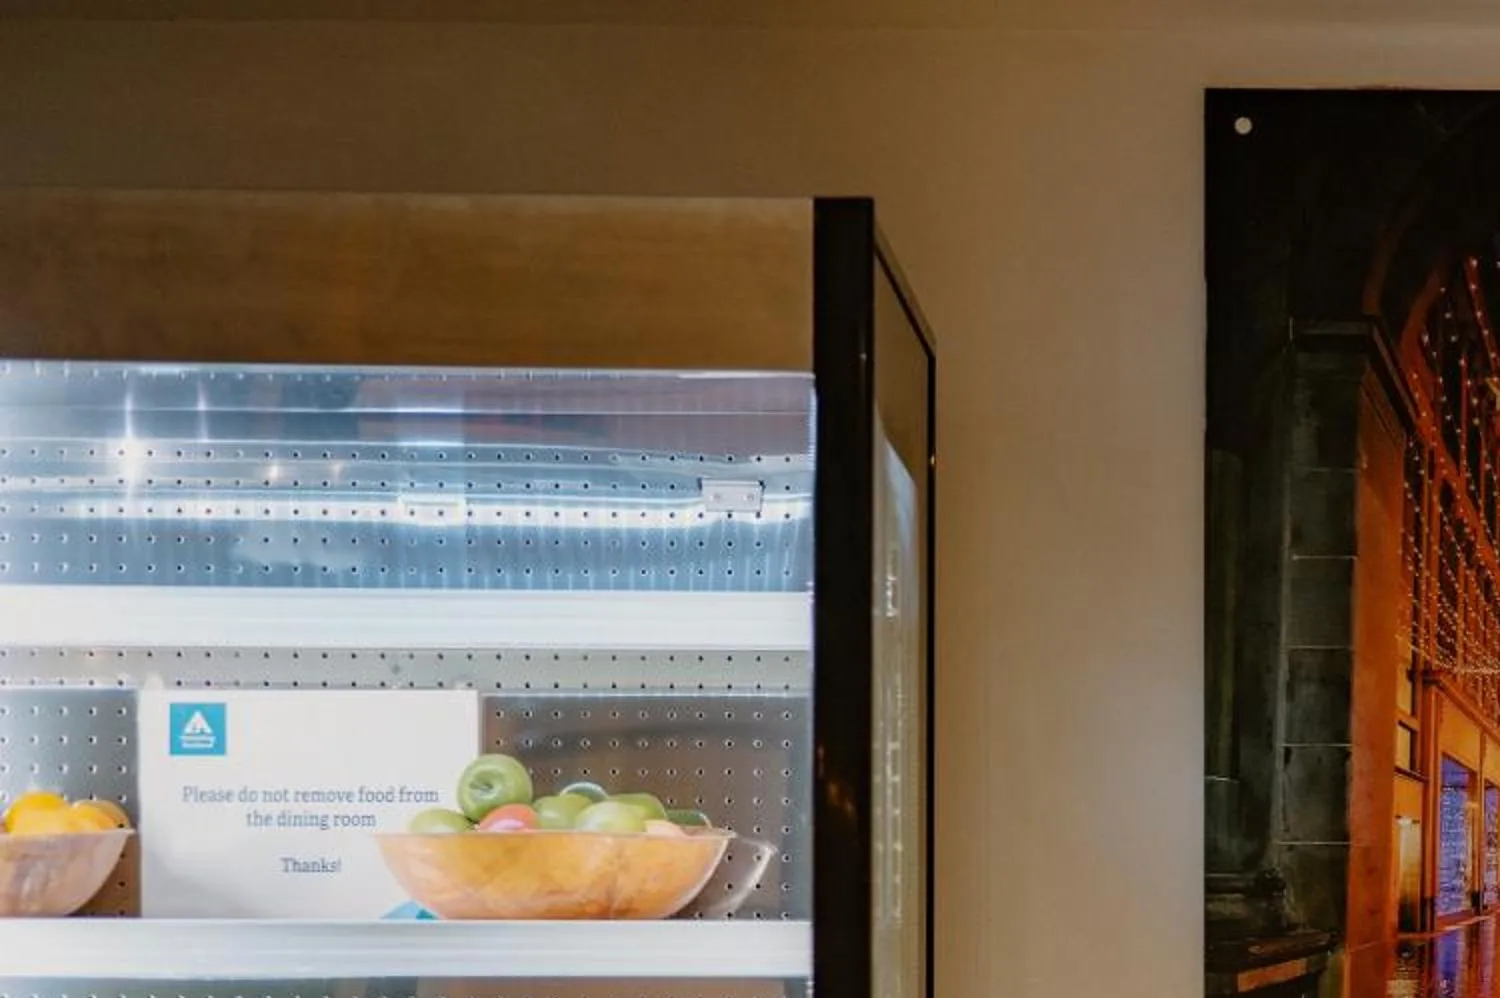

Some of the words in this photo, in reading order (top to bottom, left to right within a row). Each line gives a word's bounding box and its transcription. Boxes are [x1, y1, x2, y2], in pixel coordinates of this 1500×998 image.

[182, 785, 233, 804] Please
[238, 785, 259, 804] do
[262, 787, 289, 804] not
[293, 788, 355, 804] remove
[358, 785, 396, 804] food
[398, 785, 440, 804] from
[246, 810, 275, 828] the
[277, 810, 330, 831] dining
[333, 813, 377, 828] room
[280, 857, 342, 874] Thanks!
